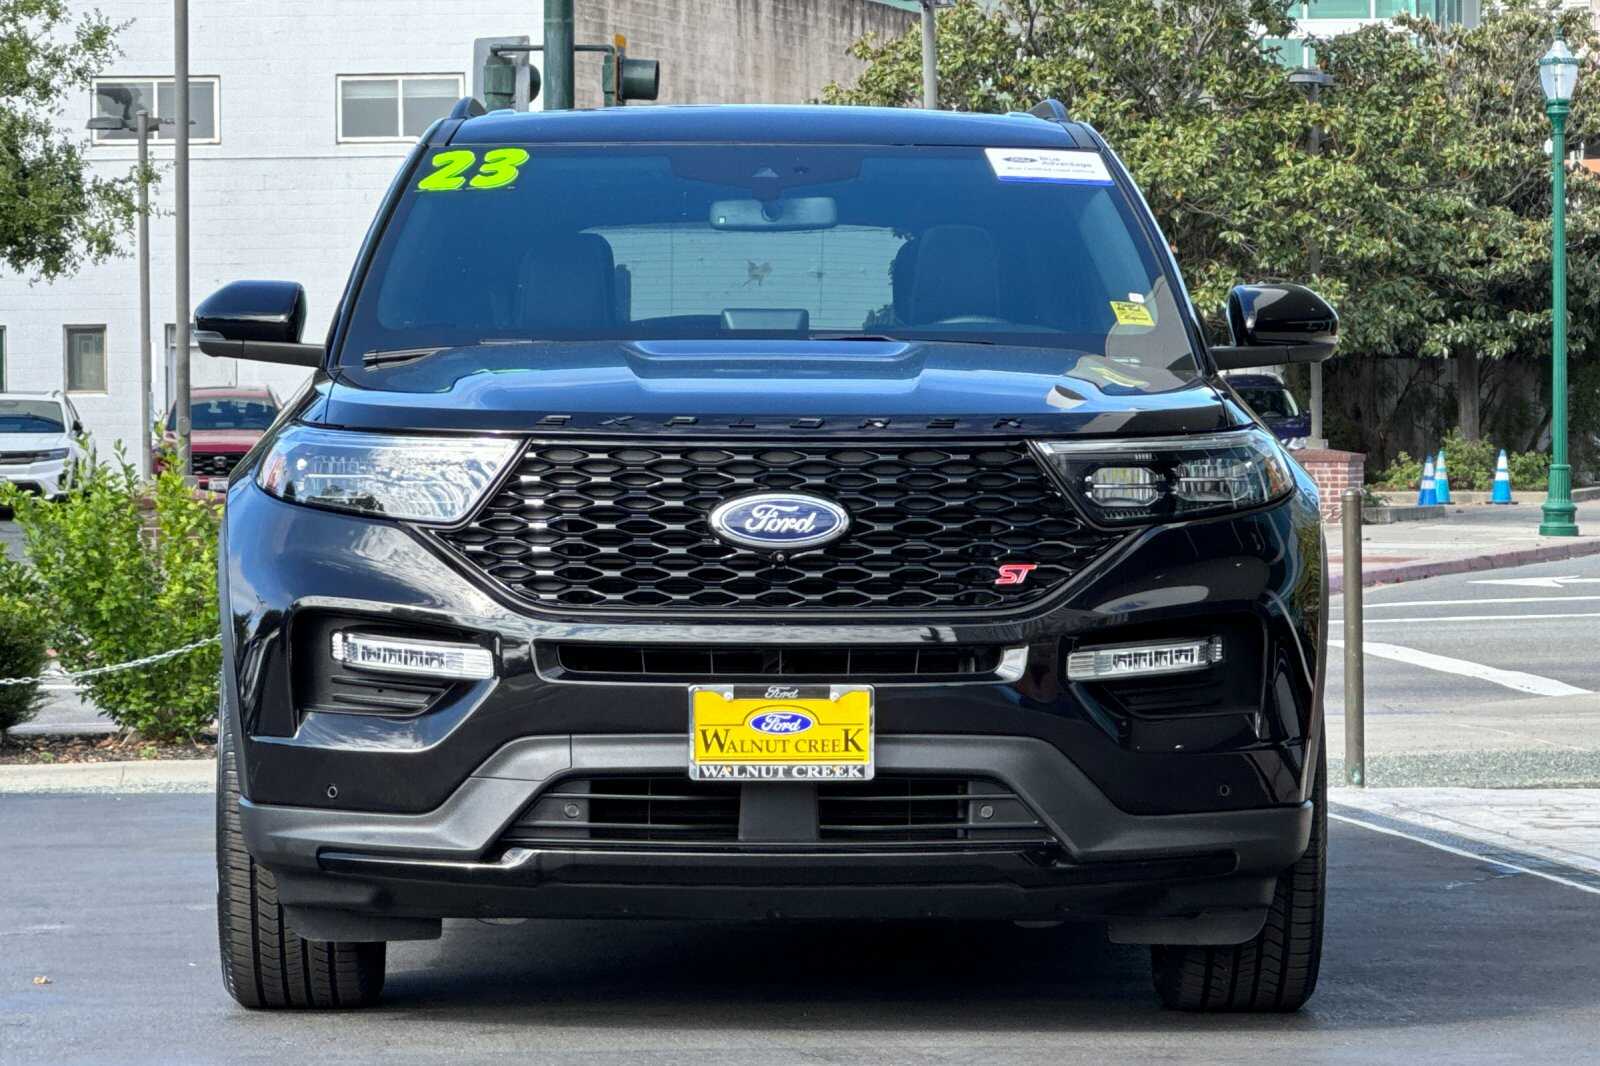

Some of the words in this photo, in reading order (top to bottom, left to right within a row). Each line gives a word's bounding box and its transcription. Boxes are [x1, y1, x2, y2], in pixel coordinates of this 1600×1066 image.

[418, 150, 529, 190] 23
[536, 414, 1025, 428] EXPLORER
[745, 504, 817, 533] Ford
[995, 564, 1038, 584] ST
[765, 686, 799, 699] Ford
[761, 713, 801, 732] Ford
[699, 728, 791, 753] WALNUT
[794, 728, 864, 753] CREEK
[702, 765, 790, 778] WALNUT
[791, 765, 862, 778] CREEK
